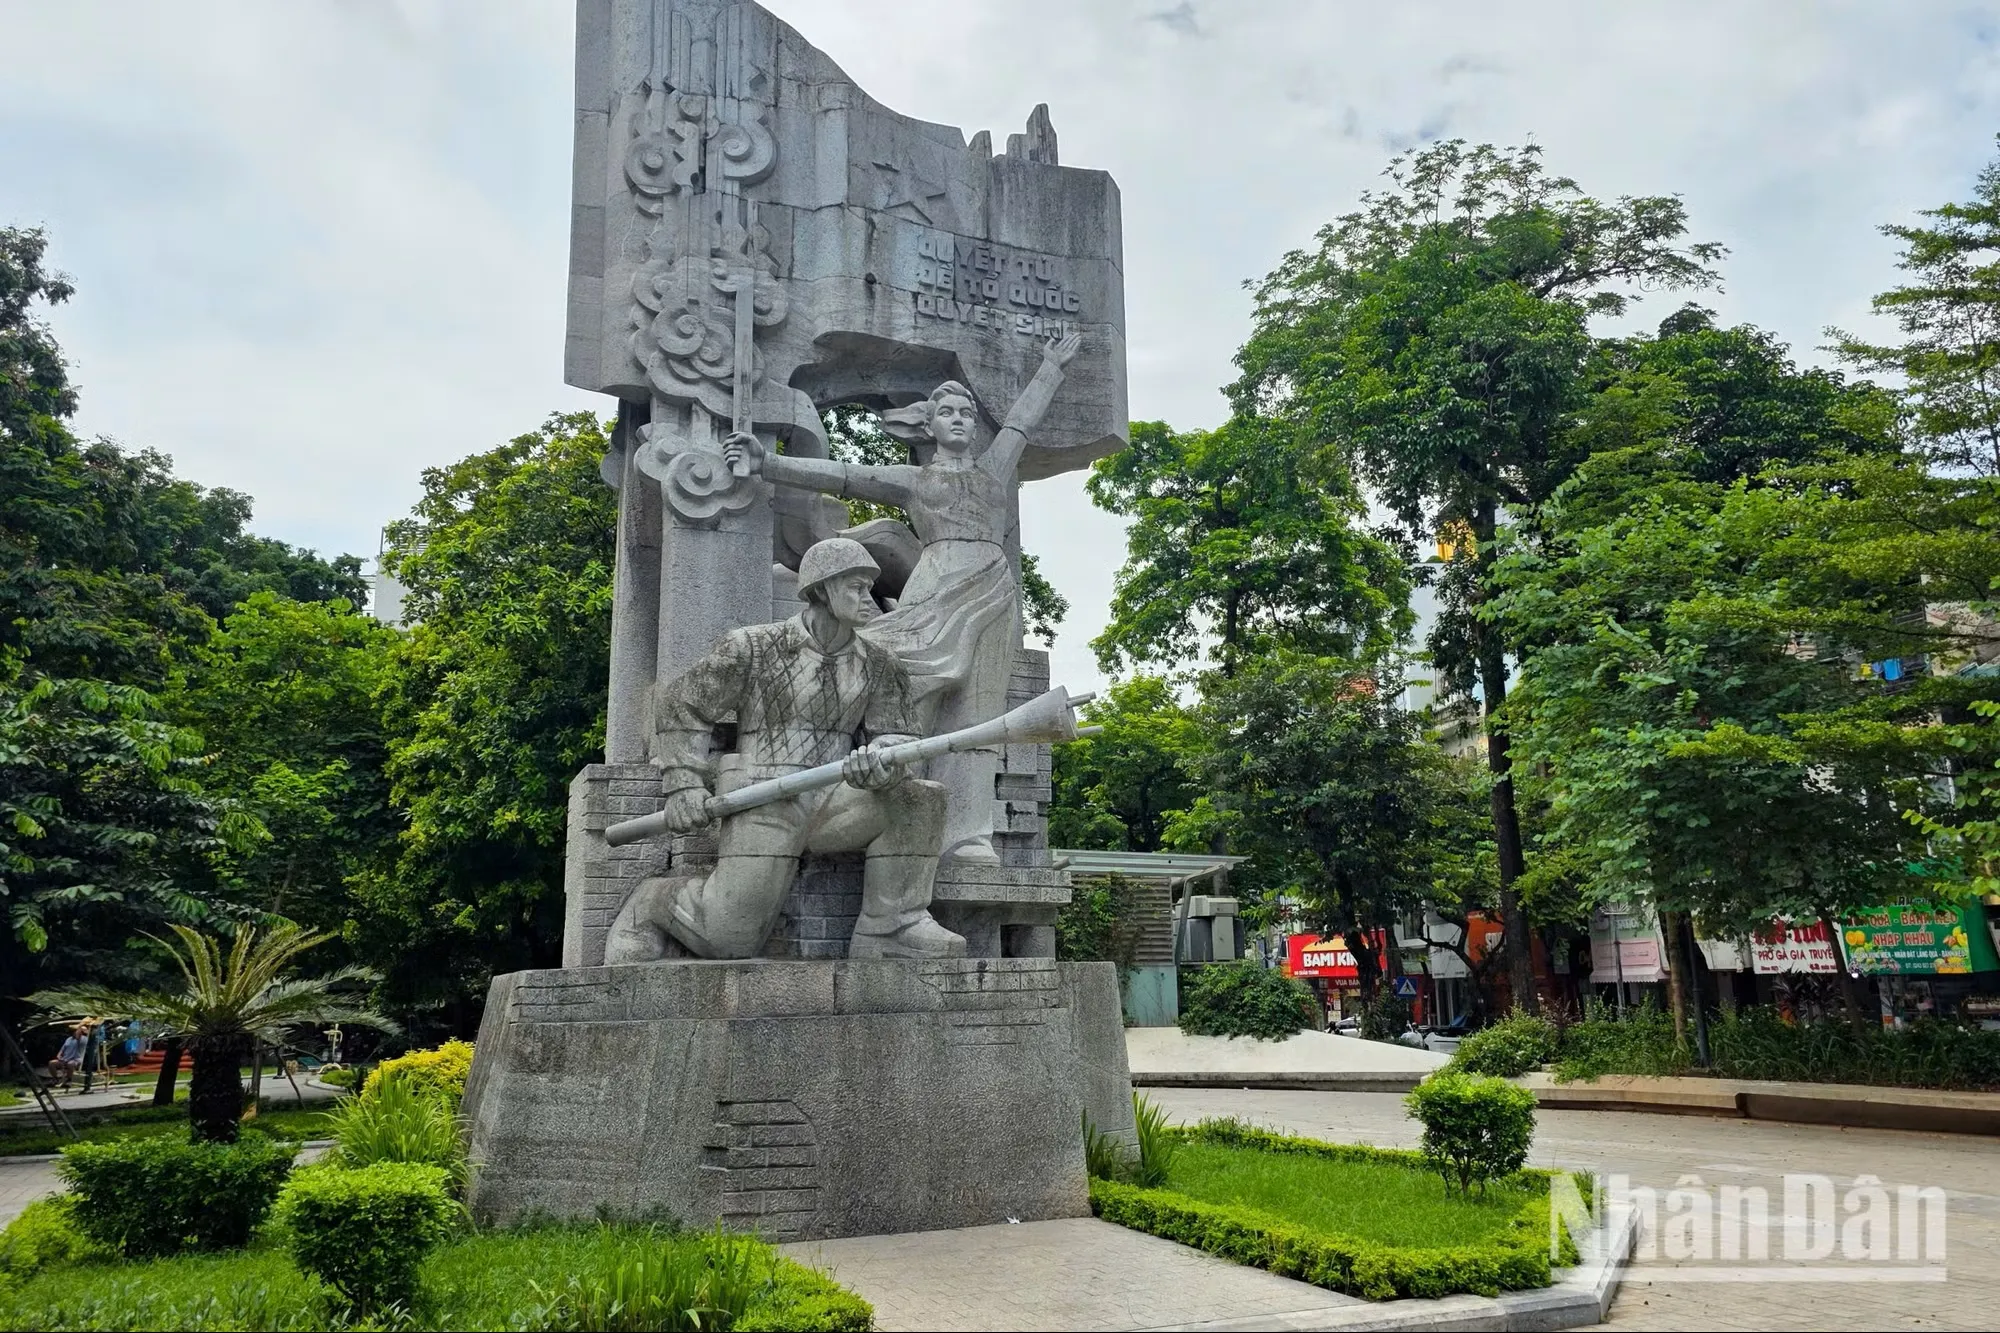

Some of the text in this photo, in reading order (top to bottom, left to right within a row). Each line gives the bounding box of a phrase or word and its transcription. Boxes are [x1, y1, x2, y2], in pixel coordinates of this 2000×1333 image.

[1009, 282, 1080, 313] QUỐC
[1303, 952, 1359, 967] BAMI KIN
[1776, 947, 1788, 960] GÀ
[1790, 949, 1807, 960] GIA
